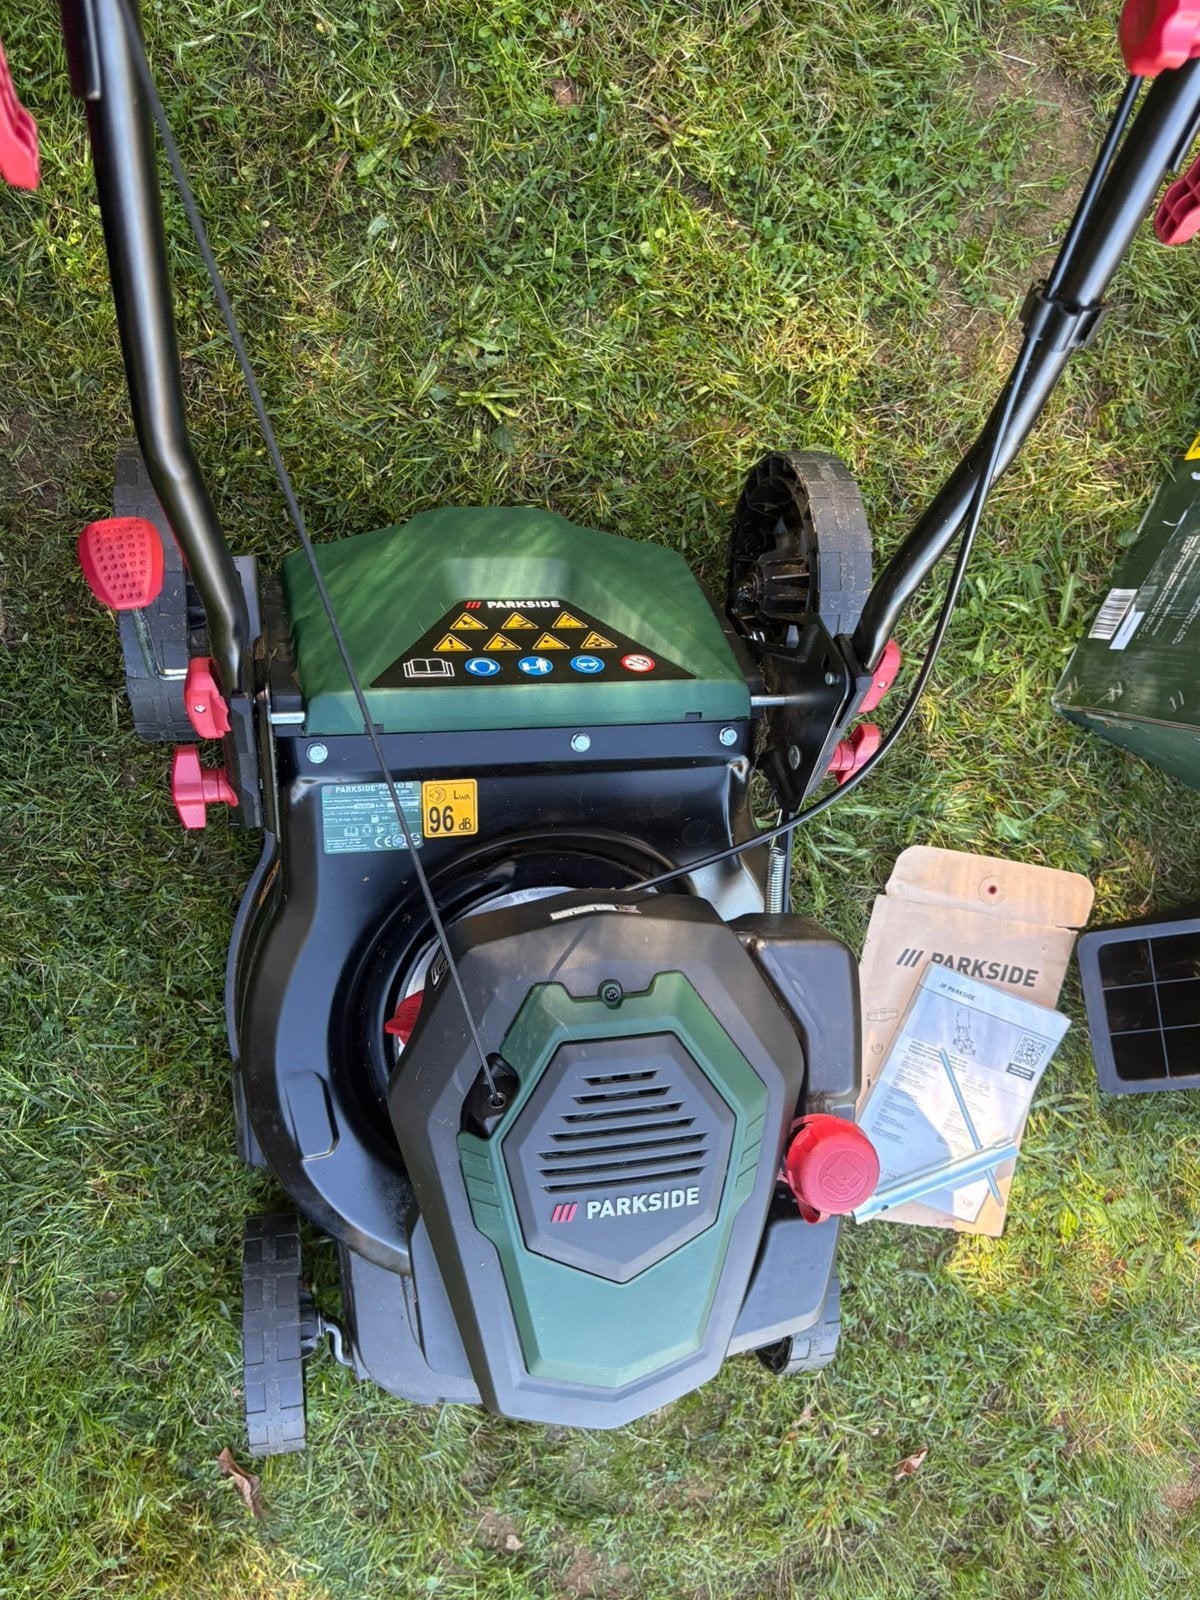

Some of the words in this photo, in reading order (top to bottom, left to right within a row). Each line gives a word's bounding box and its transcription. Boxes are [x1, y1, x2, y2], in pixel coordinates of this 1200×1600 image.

[429, 805, 454, 833] 96
[458, 817, 472, 831] dB
[931, 952, 1039, 987] PARKSIDE
[947, 986, 976, 1001] PARKSIDE
[587, 1187, 700, 1219] PARKSIDE
